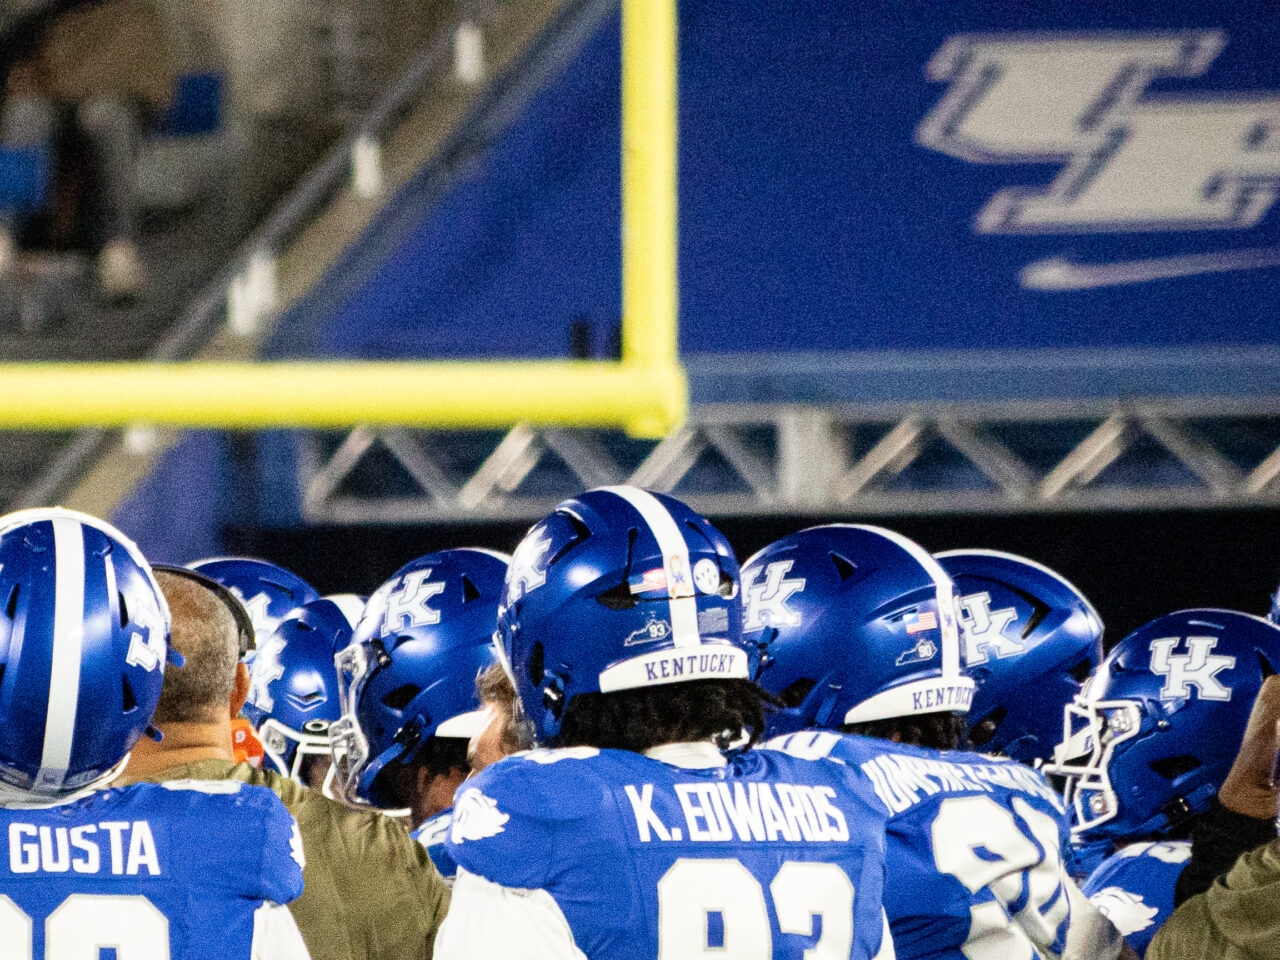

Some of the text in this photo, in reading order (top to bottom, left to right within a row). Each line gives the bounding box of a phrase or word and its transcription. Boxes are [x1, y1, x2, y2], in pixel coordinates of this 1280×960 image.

[380, 568, 446, 638] UK
[649, 623, 666, 638] 93
[645, 654, 736, 681] KENTUCKY
[1149, 636, 1237, 701] UK
[8, 818, 161, 876] GUSTA
